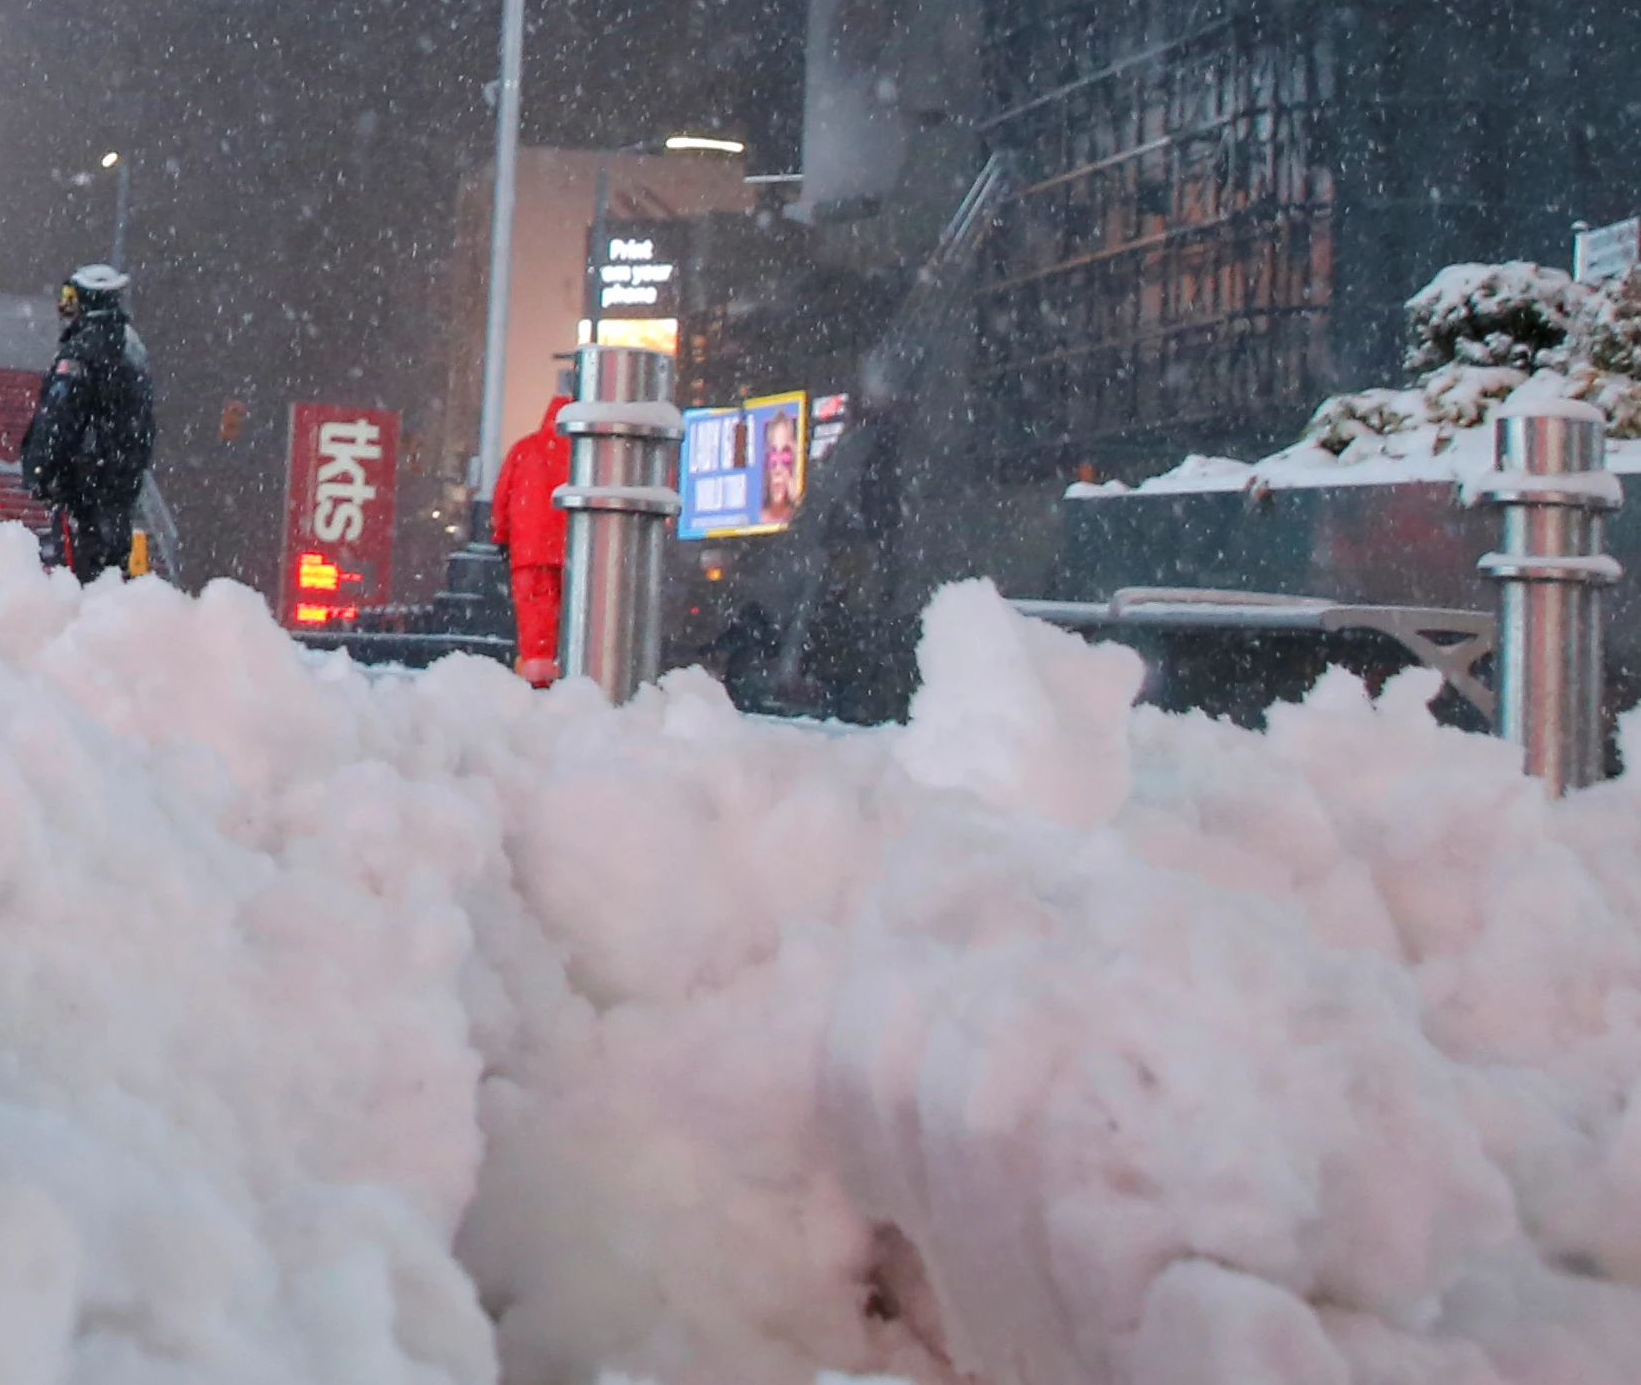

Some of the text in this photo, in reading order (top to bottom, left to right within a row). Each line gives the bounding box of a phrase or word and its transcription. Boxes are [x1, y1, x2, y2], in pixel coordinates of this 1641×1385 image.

[609, 237, 654, 261] Print
[631, 264, 673, 286] your
[601, 283, 658, 309] phone
[314, 418, 382, 543] tkts
